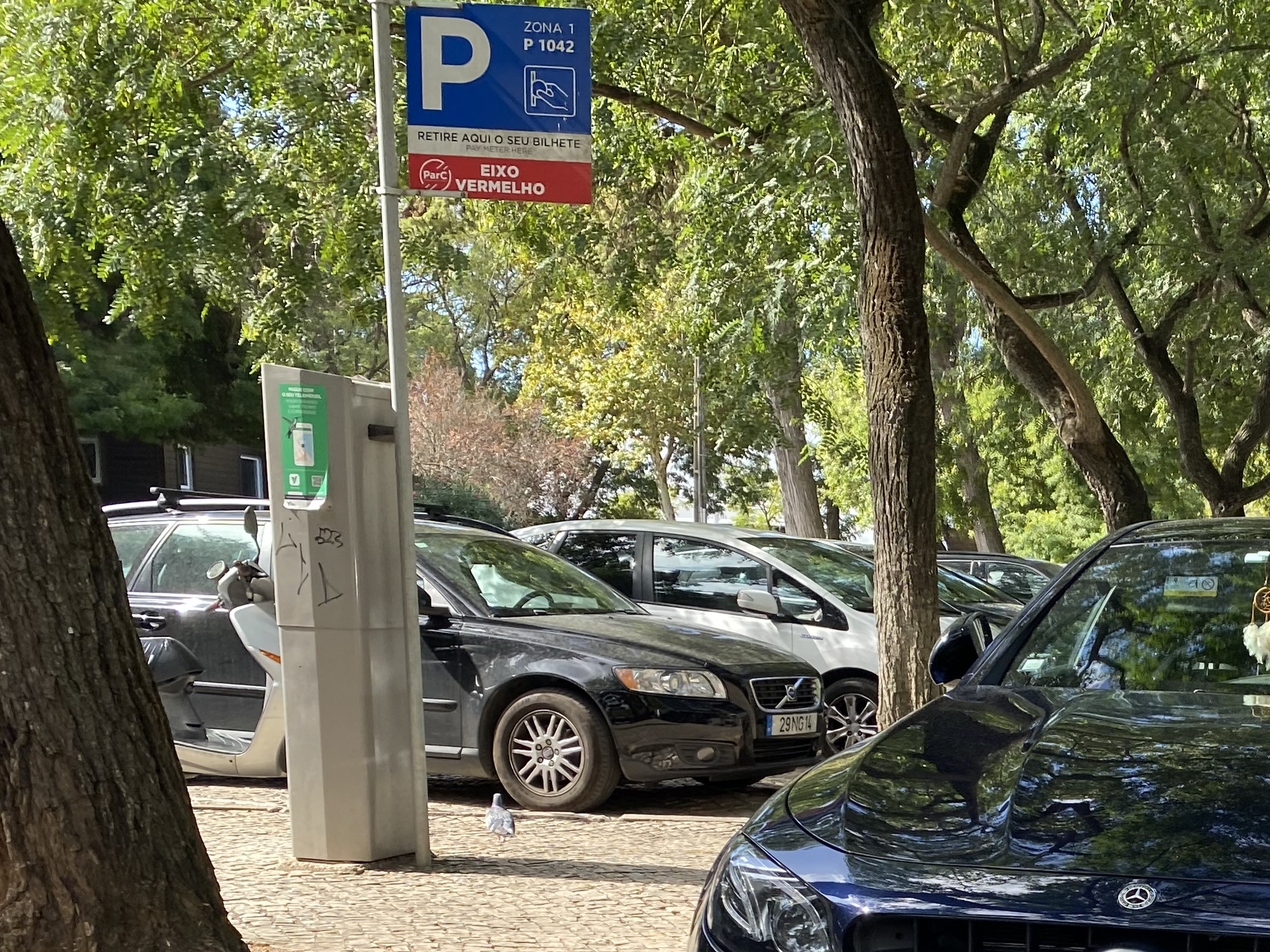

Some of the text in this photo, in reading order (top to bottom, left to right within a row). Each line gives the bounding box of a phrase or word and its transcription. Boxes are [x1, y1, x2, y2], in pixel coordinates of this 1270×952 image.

[524, 21, 575, 34] ZONA 1
[524, 39, 574, 53] P 1042
[420, 16, 491, 111] P
[418, 131, 581, 149] RETIRE AQUI O SEU BILHETE
[424, 170, 447, 179] ParC
[480, 164, 519, 178] EIXO
[455, 179, 545, 195] VERMELHO
